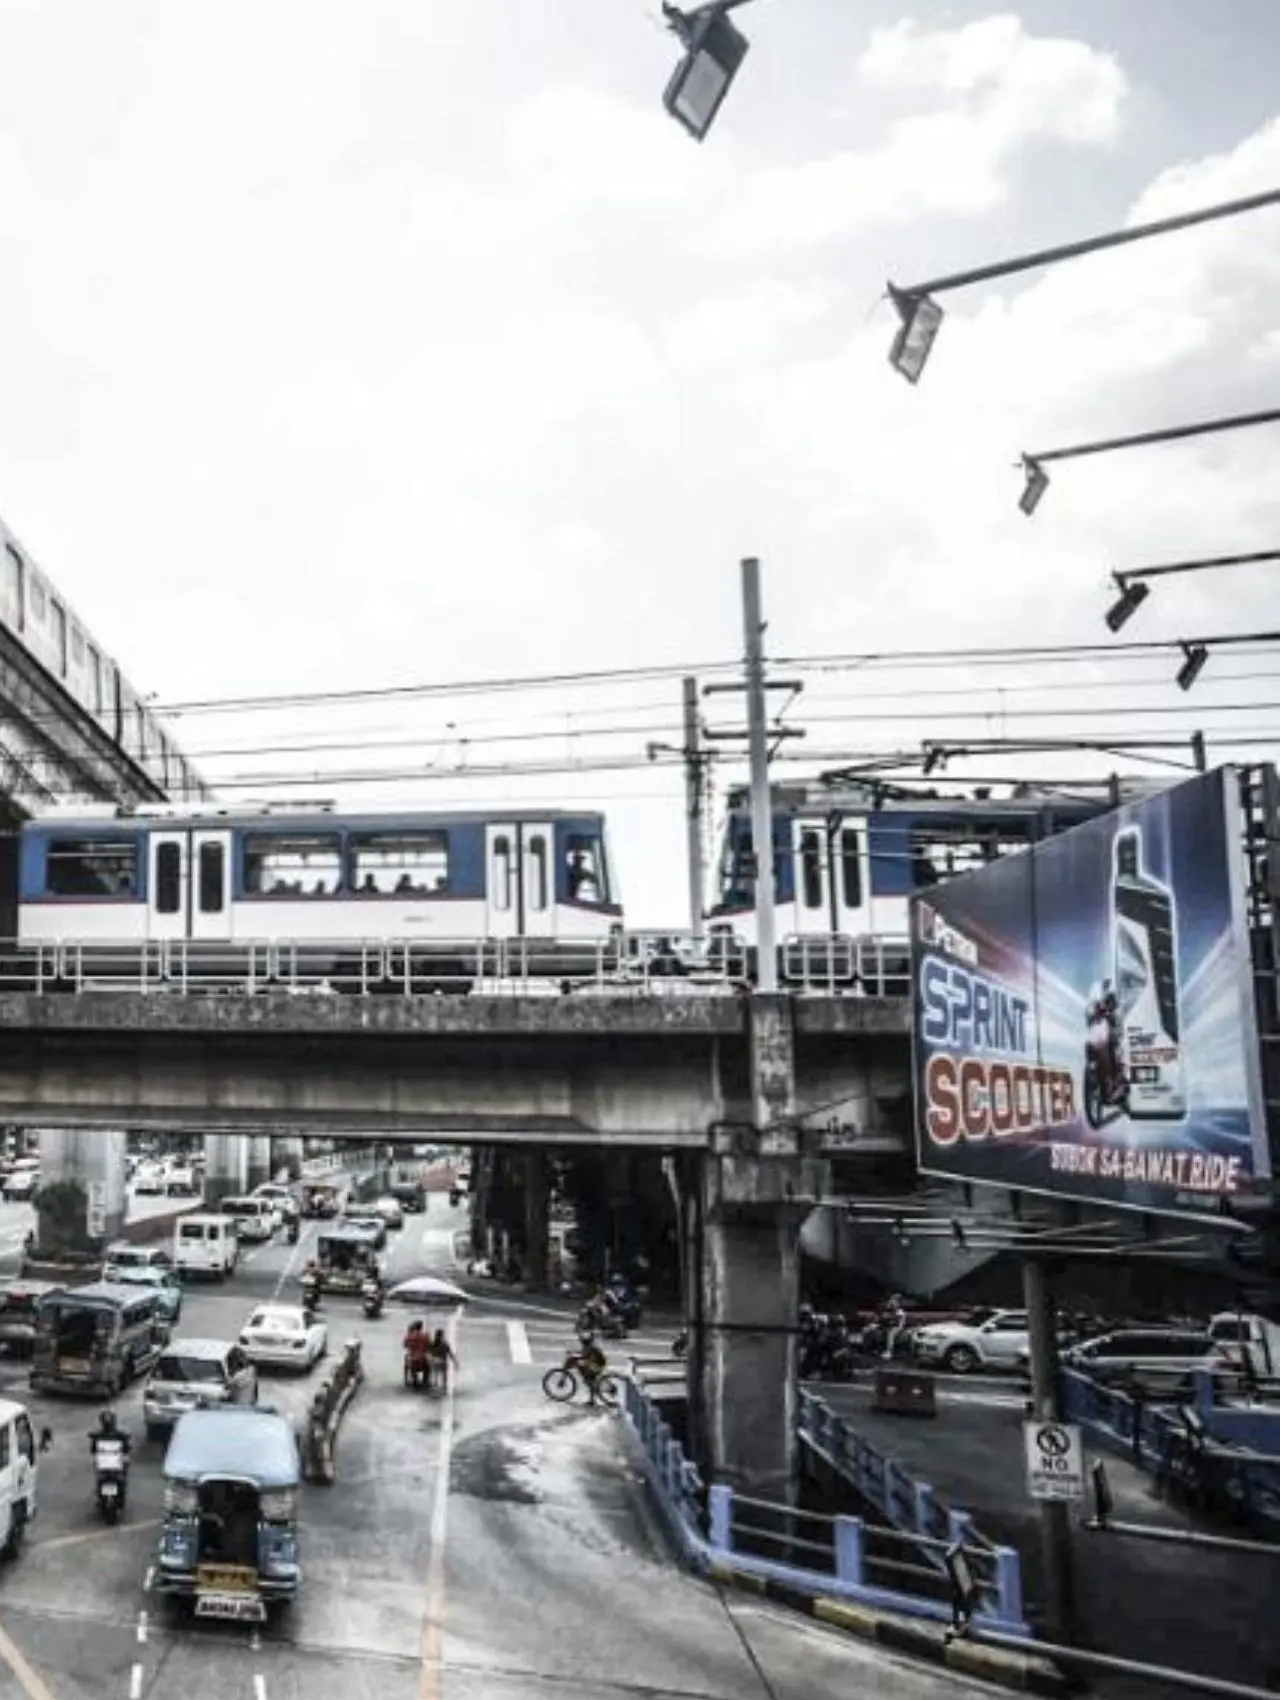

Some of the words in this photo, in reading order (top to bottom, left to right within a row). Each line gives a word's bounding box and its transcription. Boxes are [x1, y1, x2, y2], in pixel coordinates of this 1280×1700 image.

[922, 955, 1028, 1051] SPRINT
[926, 1053, 1076, 1145] SCOOTER
[1190, 1153, 1242, 1190] RIDE
[1042, 1457, 1069, 1472] NO
